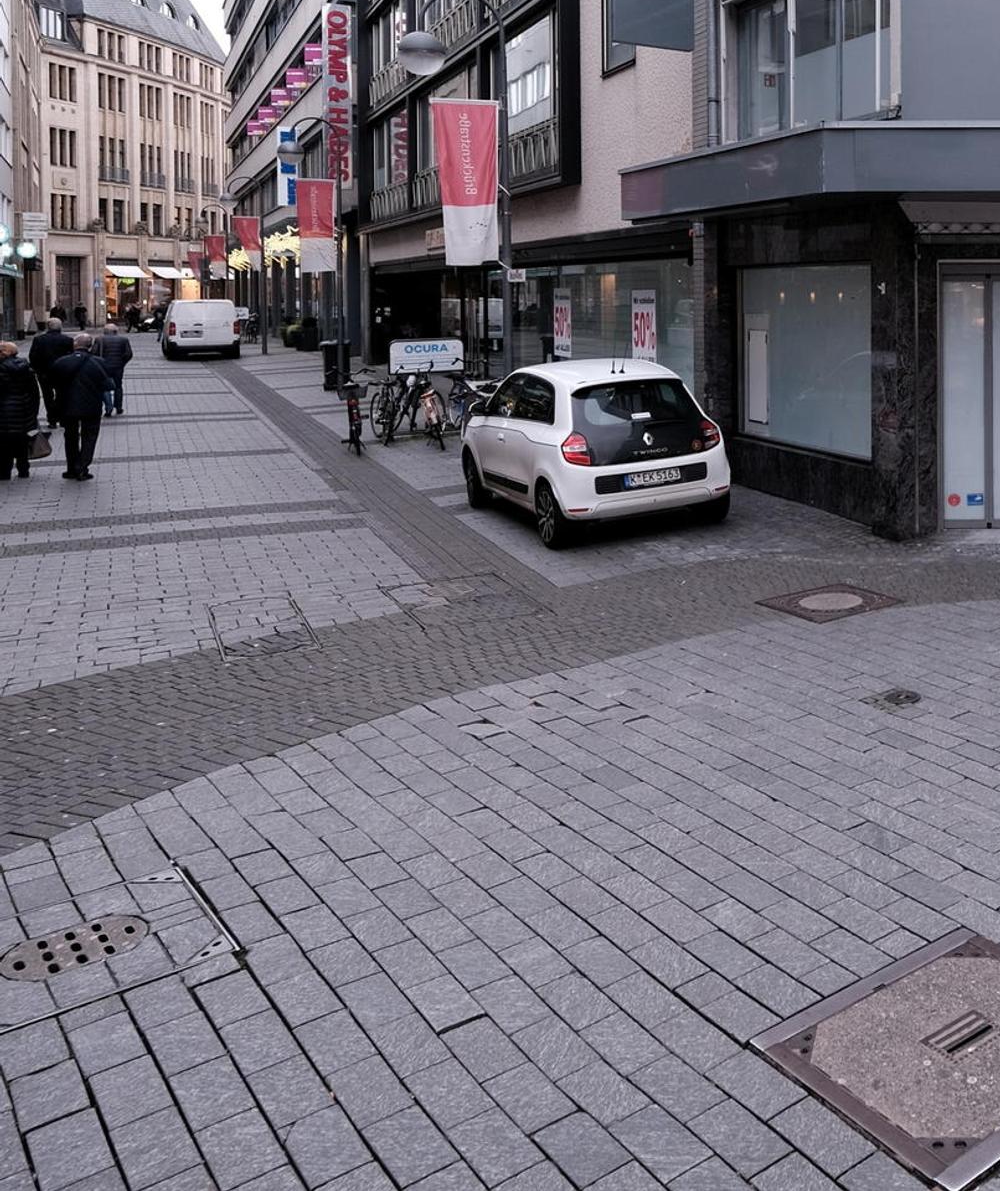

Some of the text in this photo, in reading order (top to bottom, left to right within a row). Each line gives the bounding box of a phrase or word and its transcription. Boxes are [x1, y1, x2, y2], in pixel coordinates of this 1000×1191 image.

[327, 10, 350, 183] OLYMP & HADES
[554, 306, 571, 339] 50%
[633, 312, 656, 350] 50%
[404, 343, 448, 354] OCURA
[656, 469, 680, 480] 5163
